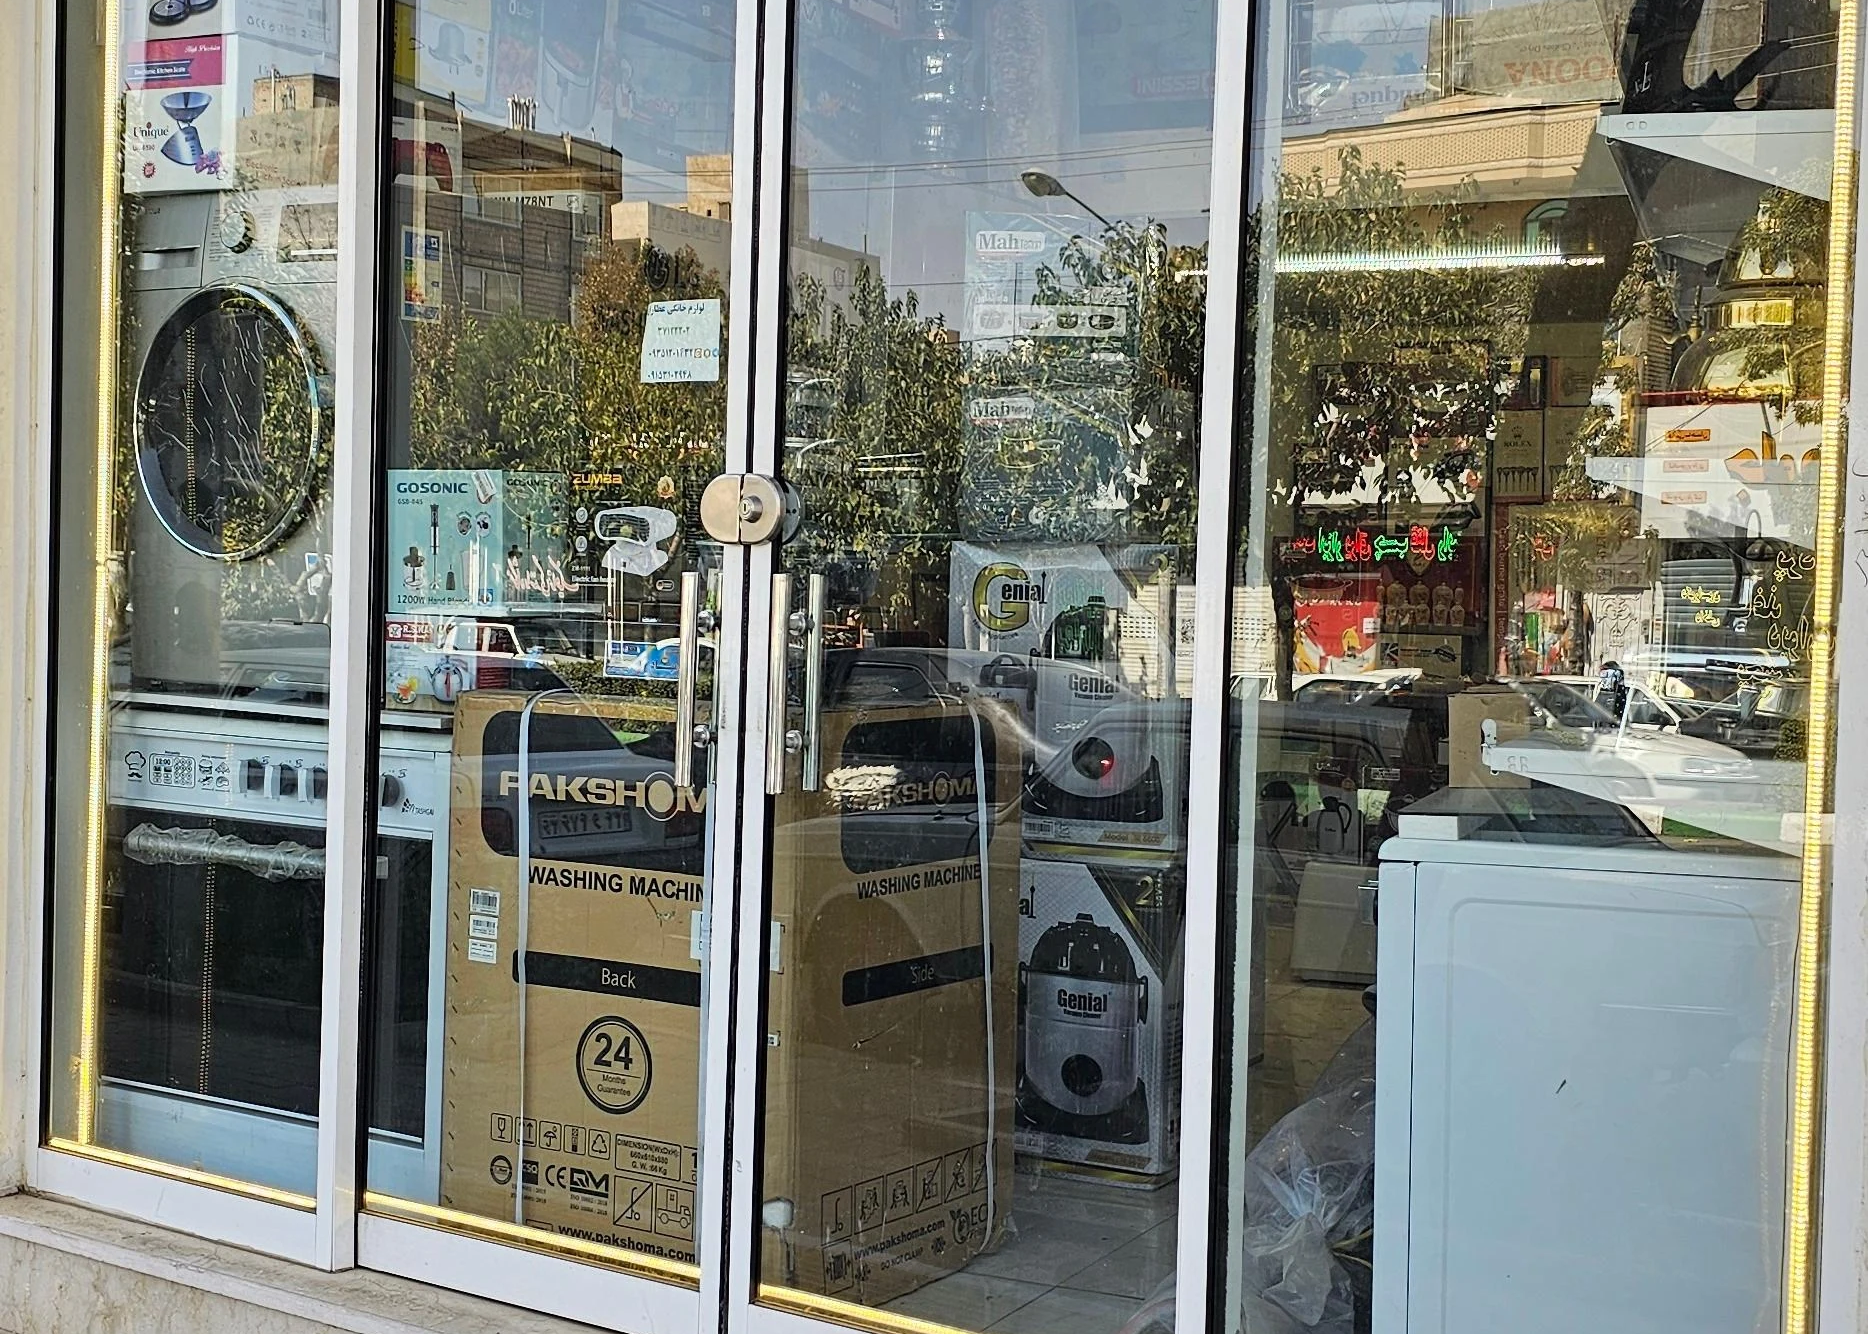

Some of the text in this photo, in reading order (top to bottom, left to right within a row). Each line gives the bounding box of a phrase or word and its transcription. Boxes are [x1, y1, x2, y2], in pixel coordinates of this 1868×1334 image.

[133, 122, 169, 140] Unique
[396, 482, 469, 494] GOSONIC
[397, 594, 426, 605] 1200W
[1068, 673, 1120, 695] Genial
[499, 770, 707, 817] PAKSHOM
[528, 865, 704, 903] WASHING MACHIN
[857, 863, 982, 900] WASHING MACHINE
[1135, 875, 1154, 906] 2
[601, 967, 637, 990] Back
[911, 966, 935, 983] Side
[1057, 989, 1108, 1013] Genial
[593, 1032, 633, 1071] 24
[596, 1083, 632, 1098] Guarantee
[602, 1073, 627, 1086] Months
[557, 1223, 696, 1264] www.pakshoma.com
[853, 1218, 945, 1261] www.pakshoma.com
